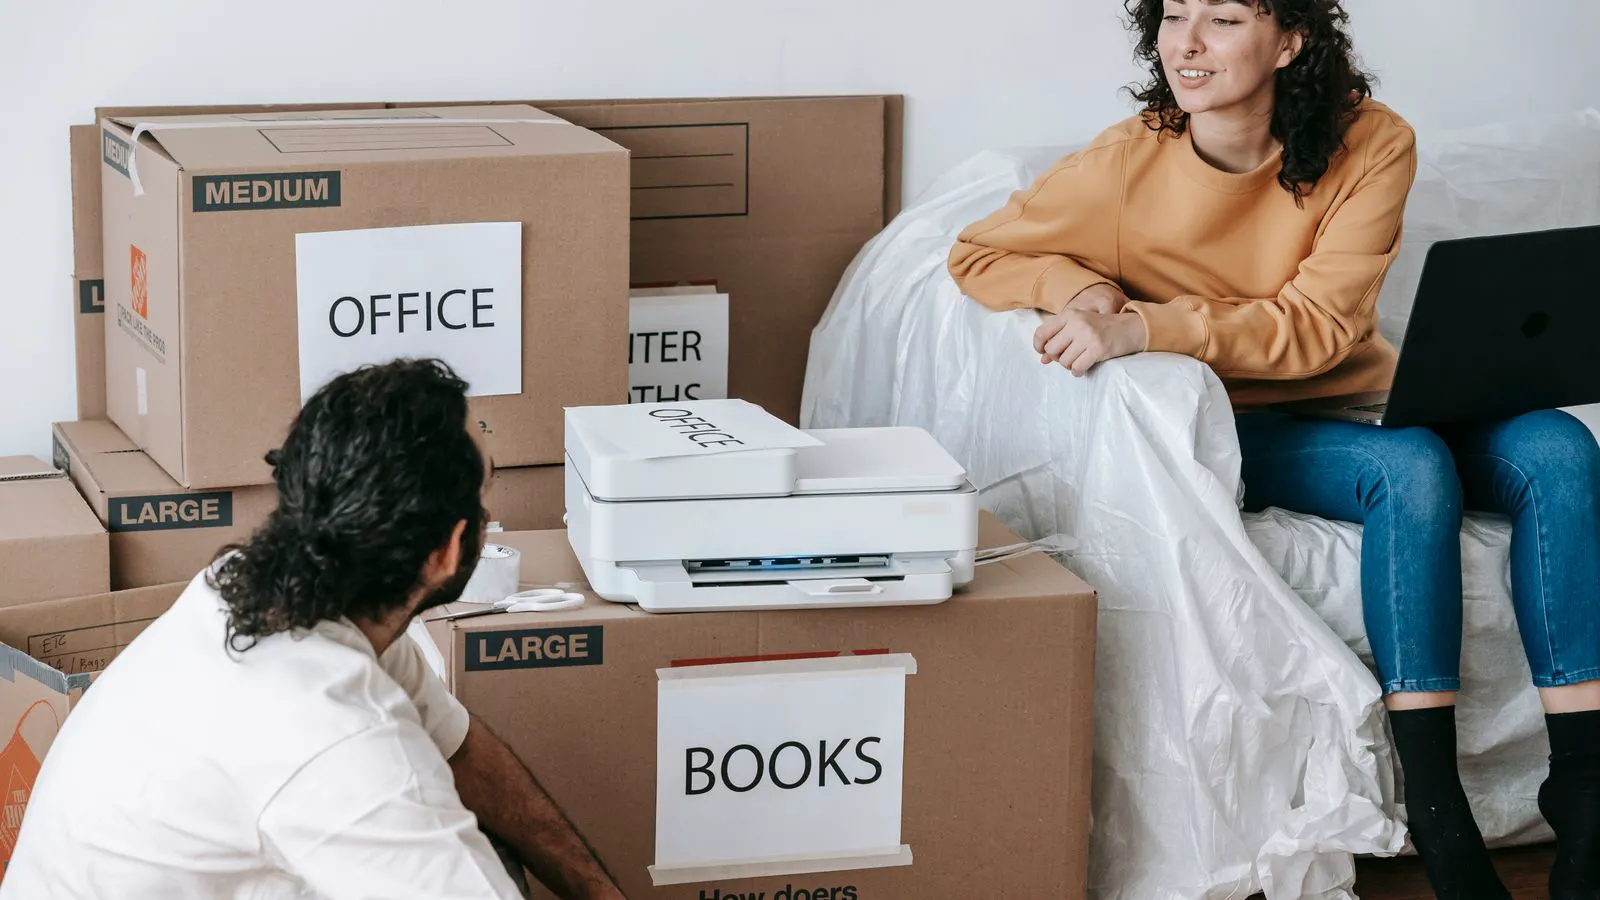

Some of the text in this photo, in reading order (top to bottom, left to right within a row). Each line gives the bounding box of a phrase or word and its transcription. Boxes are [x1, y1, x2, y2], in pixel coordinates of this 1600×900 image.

[105, 136, 131, 170] MEDIU
[205, 178, 329, 204] MEDIUM
[329, 288, 495, 337] OFFICE
[628, 330, 701, 363] TER
[649, 409, 744, 447] OFFICE
[121, 499, 220, 525] LARGE
[479, 633, 589, 663] LARGE
[685, 736, 883, 795] BOOKS
[774, 884, 858, 900] doers
